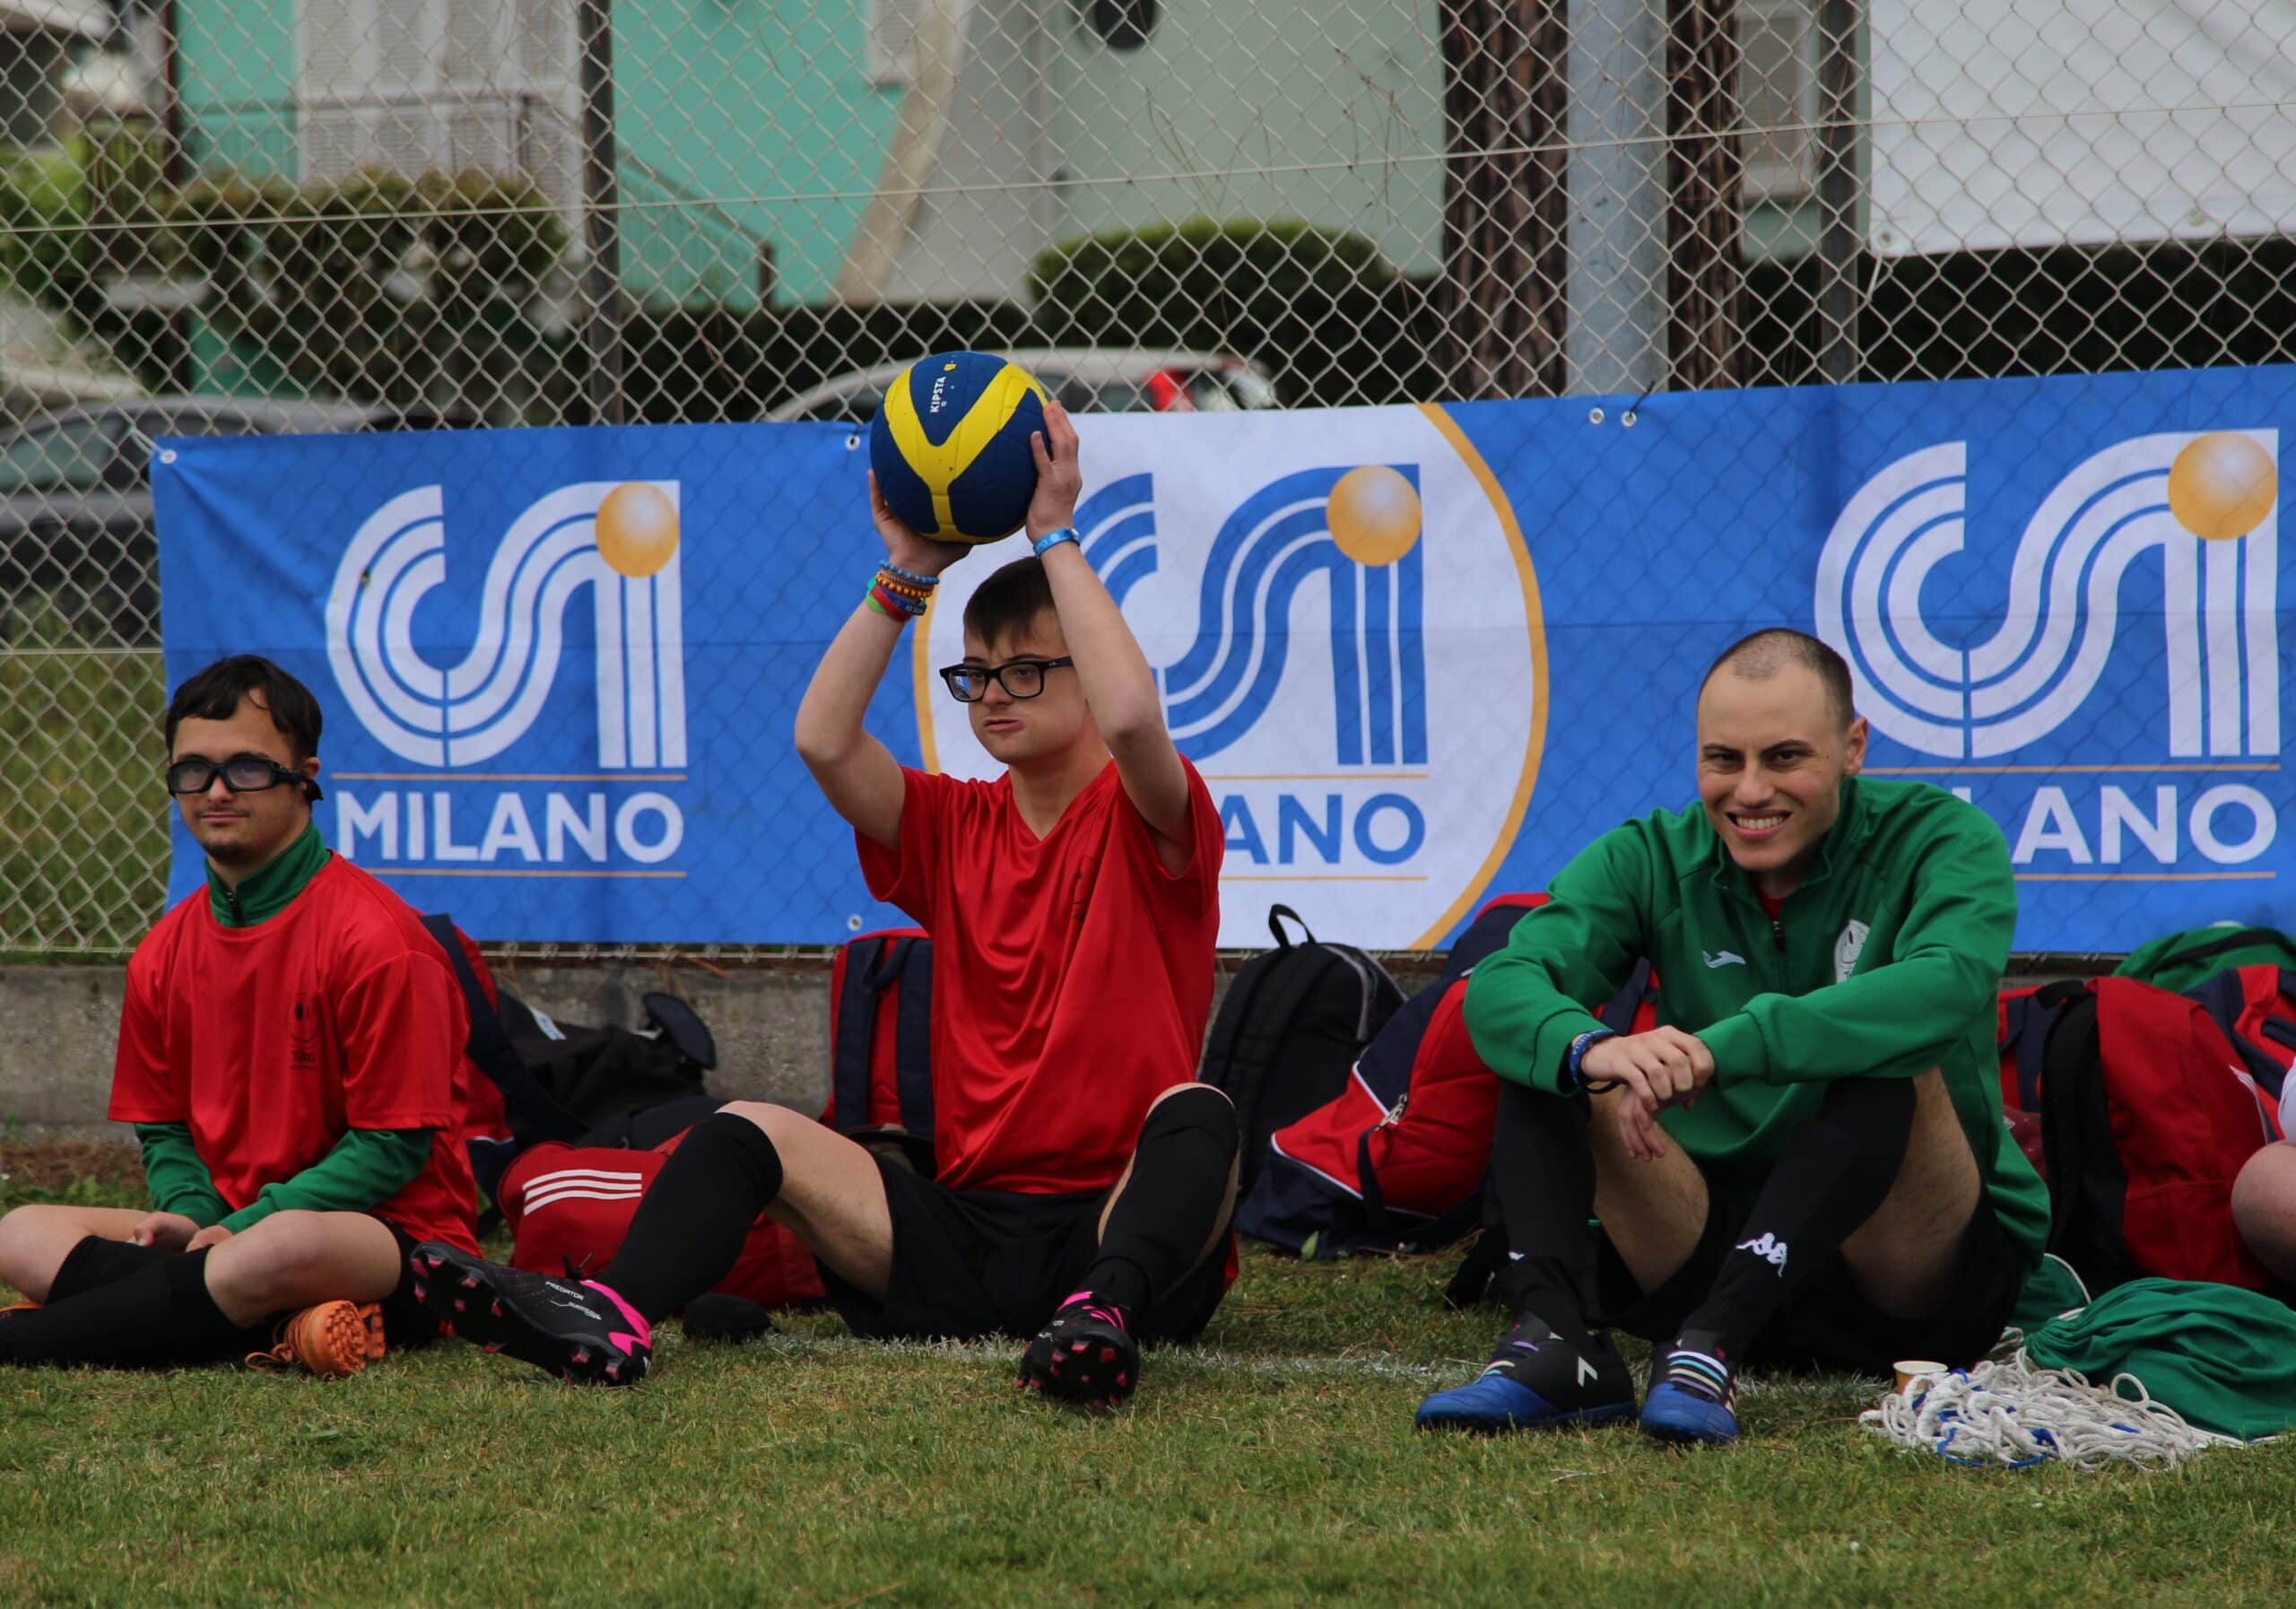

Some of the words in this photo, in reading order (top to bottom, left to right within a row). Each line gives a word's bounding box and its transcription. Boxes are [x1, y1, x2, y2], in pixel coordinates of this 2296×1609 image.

[929, 376, 947, 413] KIPSTA
[335, 790, 684, 864] MILANO
[1224, 793, 1427, 865] ANO
